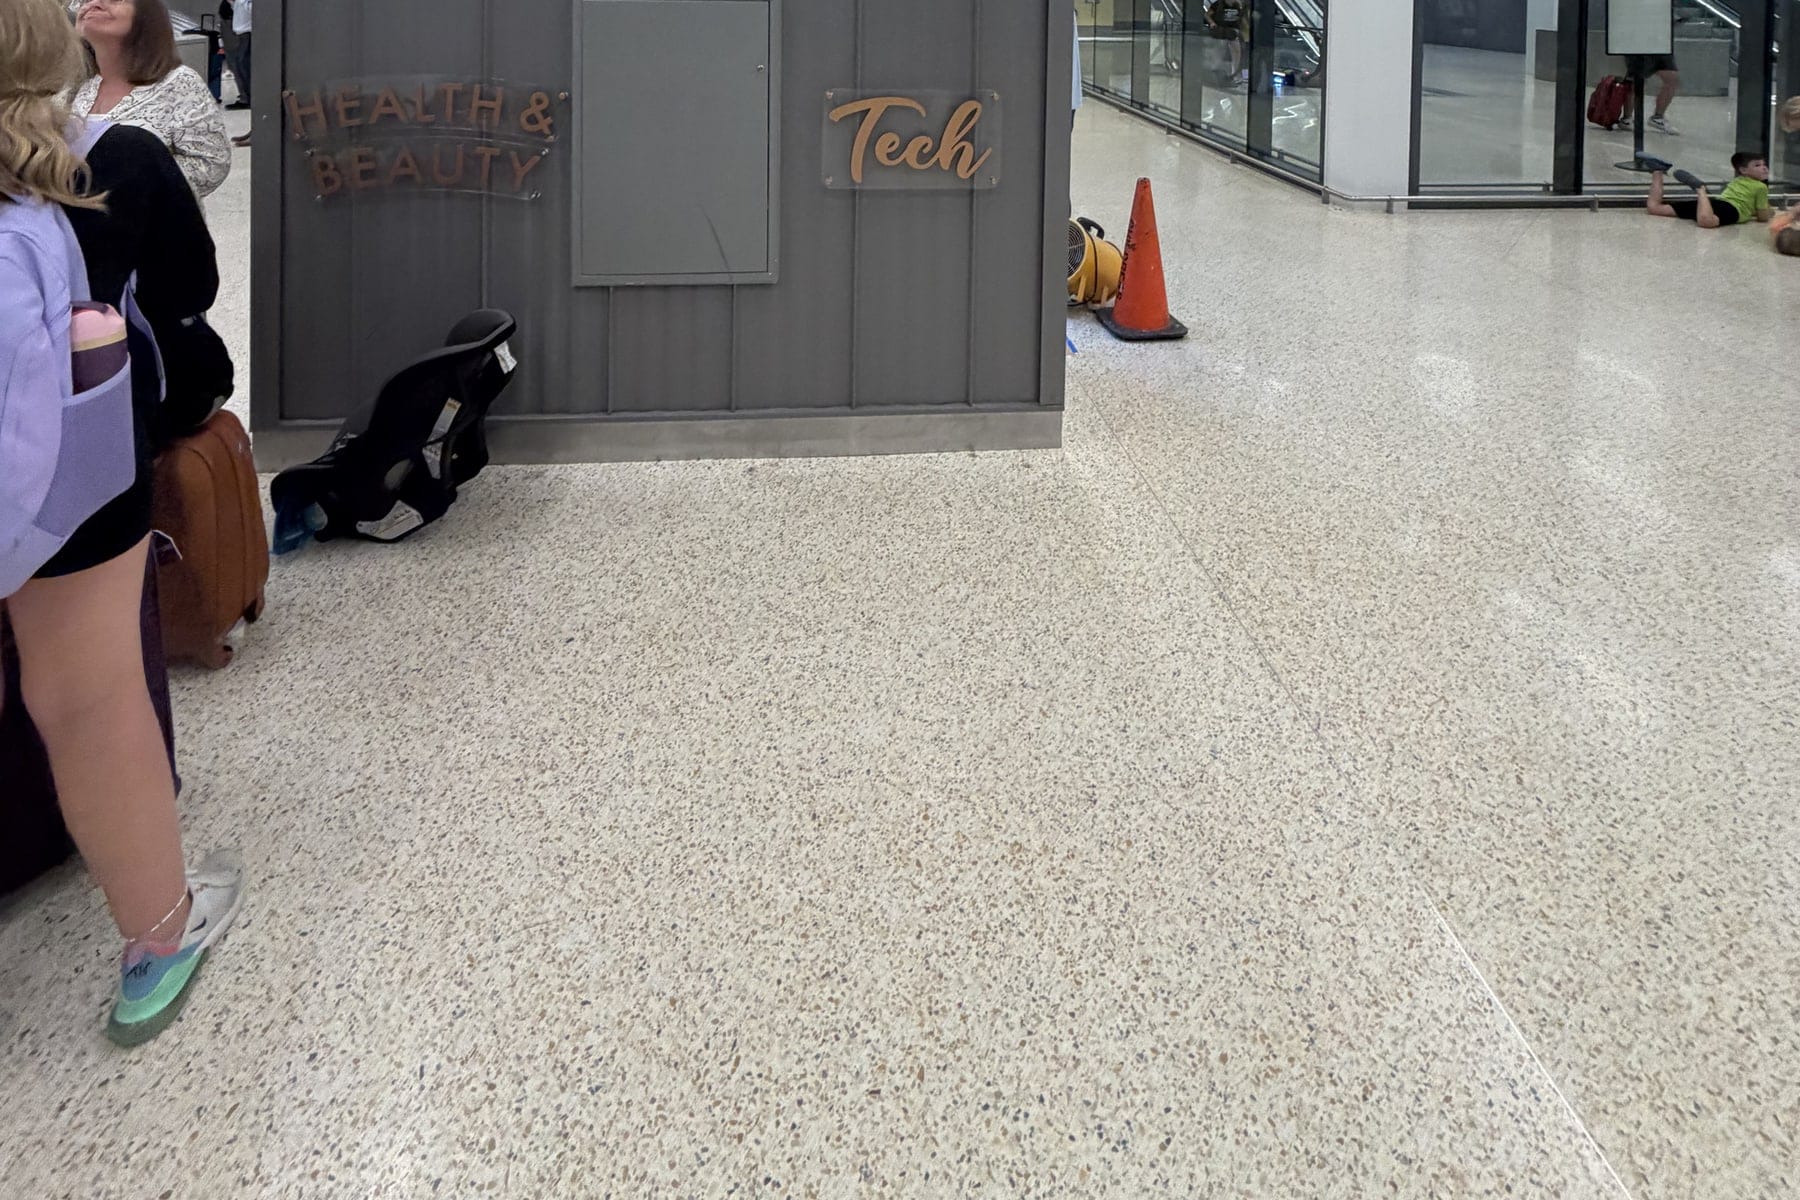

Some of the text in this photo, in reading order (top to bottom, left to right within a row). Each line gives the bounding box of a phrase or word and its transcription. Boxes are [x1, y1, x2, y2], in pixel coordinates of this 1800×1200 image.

[283, 83, 555, 135] HEALTH &
[829, 96, 993, 183] Tech
[312, 145, 541, 194] BEAUTY
